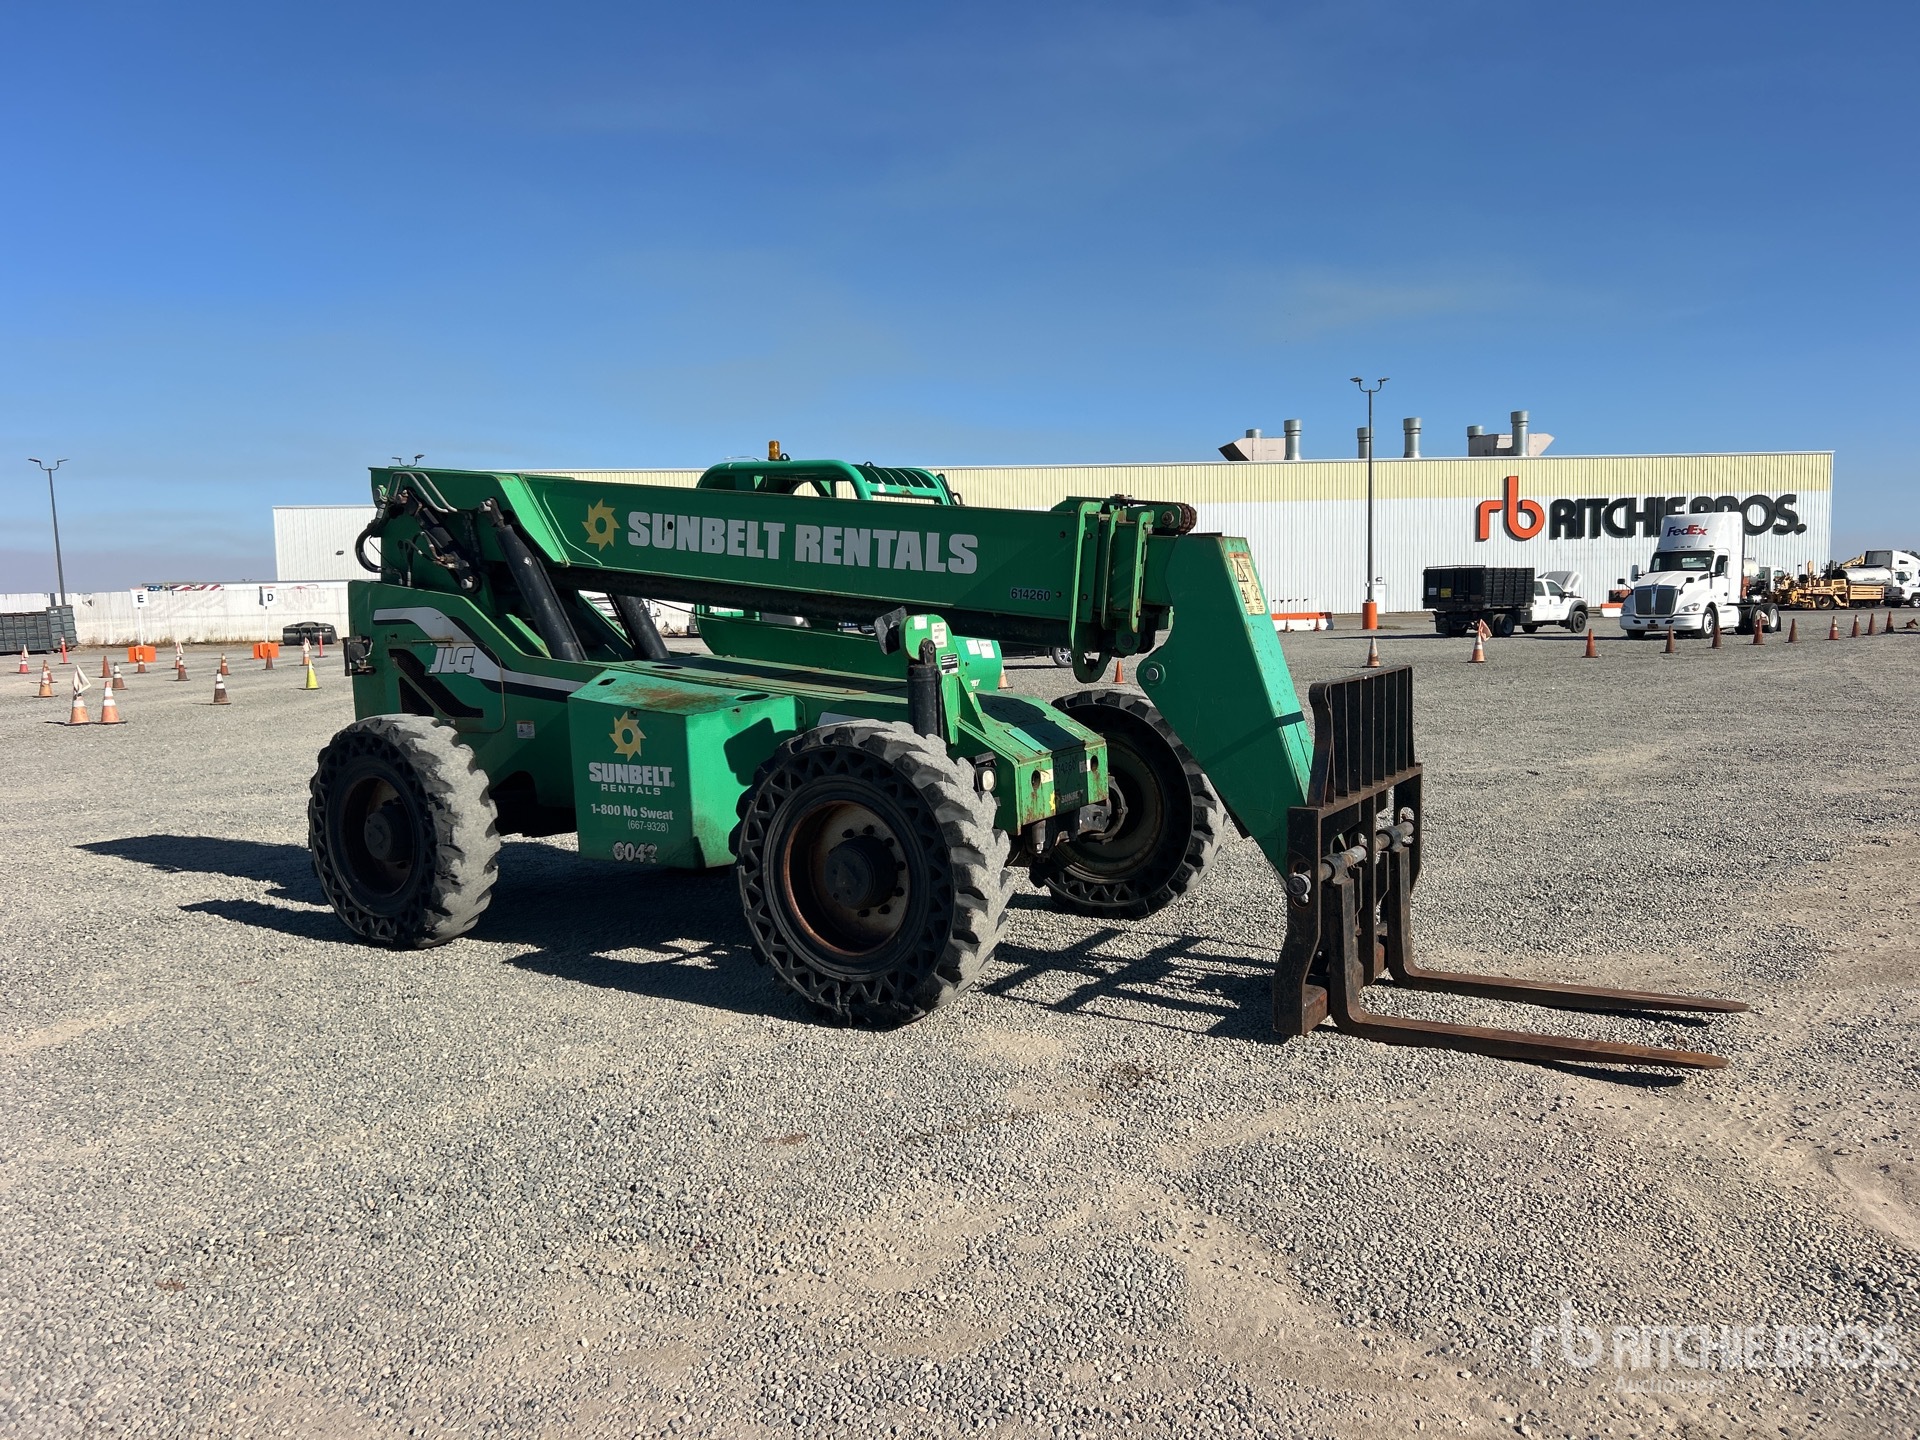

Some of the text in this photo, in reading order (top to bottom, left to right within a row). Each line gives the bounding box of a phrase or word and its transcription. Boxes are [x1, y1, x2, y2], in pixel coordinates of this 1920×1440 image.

[1666, 524, 1708, 537] FedEx
[627, 511, 979, 575] SUNBELT RENTALS
[137, 594, 144, 603] E
[266, 593, 274, 602] D
[1010, 587, 1051, 601] 614260
[428, 646, 476, 674] JLG
[588, 762, 673, 787] SUNBELT
[601, 783, 661, 796] RENTALS
[591, 803, 674, 820] 1-800 No Sweat
[627, 819, 669, 834] (667-9328)
